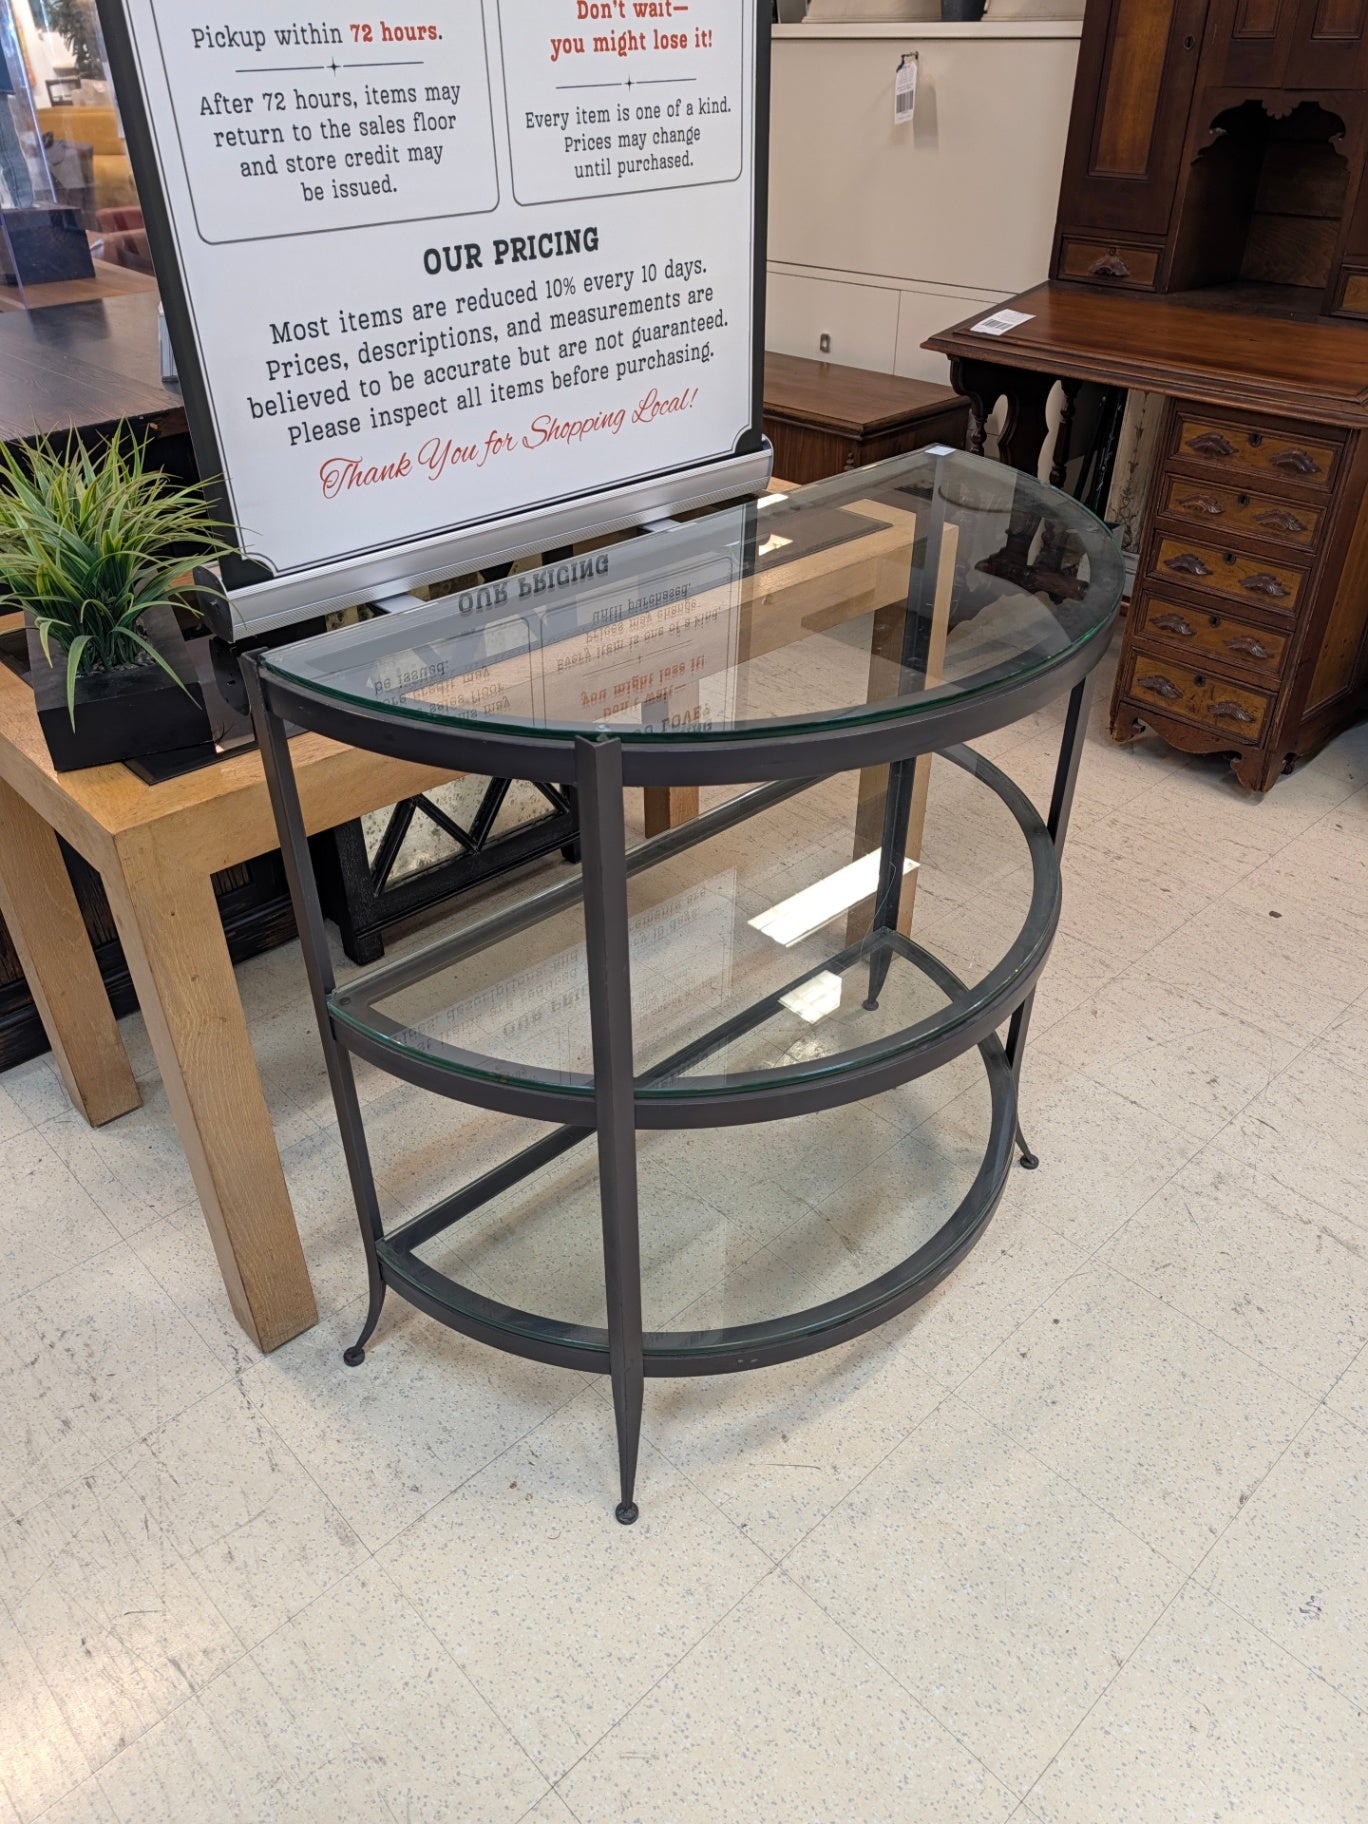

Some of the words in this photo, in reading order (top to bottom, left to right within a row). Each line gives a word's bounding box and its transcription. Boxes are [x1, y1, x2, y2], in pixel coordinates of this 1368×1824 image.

[576, 0, 626, 20] Don't
[190, 24, 266, 52] Pickup
[273, 21, 344, 46] within
[349, 23, 374, 43] 72
[379, 20, 443, 42] hours.
[550, 37, 586, 63] you
[592, 29, 647, 58] might
[652, 28, 688, 50] lose
[694, 26, 713, 49] it!
[199, 91, 254, 116] After
[261, 91, 287, 112] 72
[292, 88, 358, 110] hours,
[364, 84, 417, 106] items
[424, 84, 461, 106] may
[524, 111, 570, 131] Every
[575, 105, 611, 125] item
[616, 103, 630, 122] is
[635, 105, 661, 121] one
[666, 98, 682, 118] of
[686, 102, 694, 117] a
[698, 95, 732, 115] kind.
[212, 127, 285, 148] return
[291, 123, 313, 142] to
[319, 117, 352, 140] the
[358, 114, 406, 137] sales
[412, 111, 457, 133] floor
[563, 132, 612, 153] Prices
[617, 132, 647, 151] may
[652, 125, 701, 146] change
[239, 153, 279, 178] and
[285, 154, 337, 174] store
[344, 143, 401, 168] credit
[406, 145, 444, 166] may
[573, 157, 612, 179] until
[616, 149, 694, 179] purchased.
[299, 181, 325, 202] be
[331, 173, 398, 199] issued.
[423, 242, 484, 276] OUR
[492, 226, 600, 266] PRICING
[268, 316, 331, 345] Most
[338, 307, 403, 334] items
[412, 300, 447, 321] are
[455, 279, 539, 315] reduced
[544, 275, 577, 300] 10%
[583, 270, 635, 293] every
[641, 263, 657, 284] 10
[664, 258, 707, 282] days.
[265, 352, 349, 382] Prices,
[357, 325, 501, 364] descriptions,
[506, 311, 543, 338] and
[549, 291, 681, 329] measurements
[687, 287, 714, 305] are
[246, 379, 352, 420] believed
[358, 379, 381, 398] to
[387, 370, 415, 392] be
[423, 353, 511, 388] accurate
[517, 344, 551, 367] but
[558, 339, 588, 359] are
[594, 330, 625, 352] not
[631, 308, 729, 350] guaranteed.
[287, 416, 361, 447] Please
[369, 396, 449, 430] inspect
[456, 385, 483, 411] all
[489, 378, 544, 404] items
[550, 364, 609, 391] before
[615, 340, 715, 382] purchasing.
[319, 451, 413, 500] Thank
[417, 437, 479, 481] You
[476, 429, 518, 468] for
[521, 408, 626, 450] Shopping
[631, 387, 699, 424] Local!
